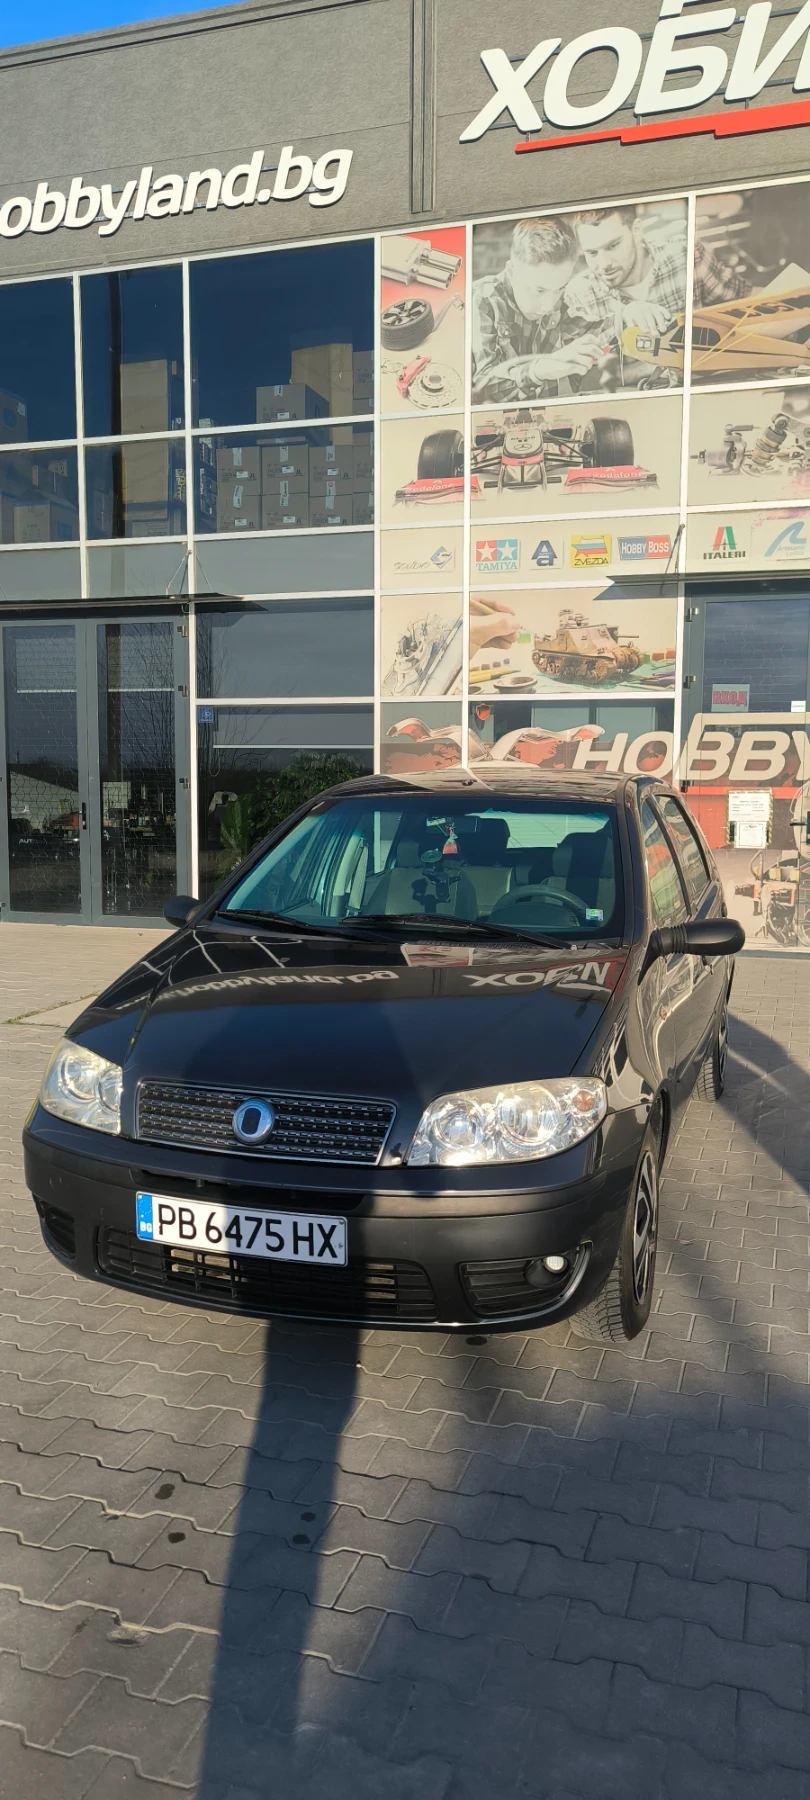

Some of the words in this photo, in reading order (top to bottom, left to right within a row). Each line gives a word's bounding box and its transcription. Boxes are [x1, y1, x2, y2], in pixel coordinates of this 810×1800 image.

[0, 146, 353, 238] obbyland.bg
[621, 542, 647, 554] HOBBY
[648, 541, 669, 553] BOSS
[703, 550, 746, 560] ITALERI
[476, 561, 518, 571] TAMIYA
[574, 557, 609, 566] ZVEZDA
[713, 690, 747, 706] ВХОД
[139, 1221, 153, 1233] BG
[157, 1203, 197, 1240] PB
[205, 1211, 285, 1253] 6475
[292, 1221, 338, 1259] HX
